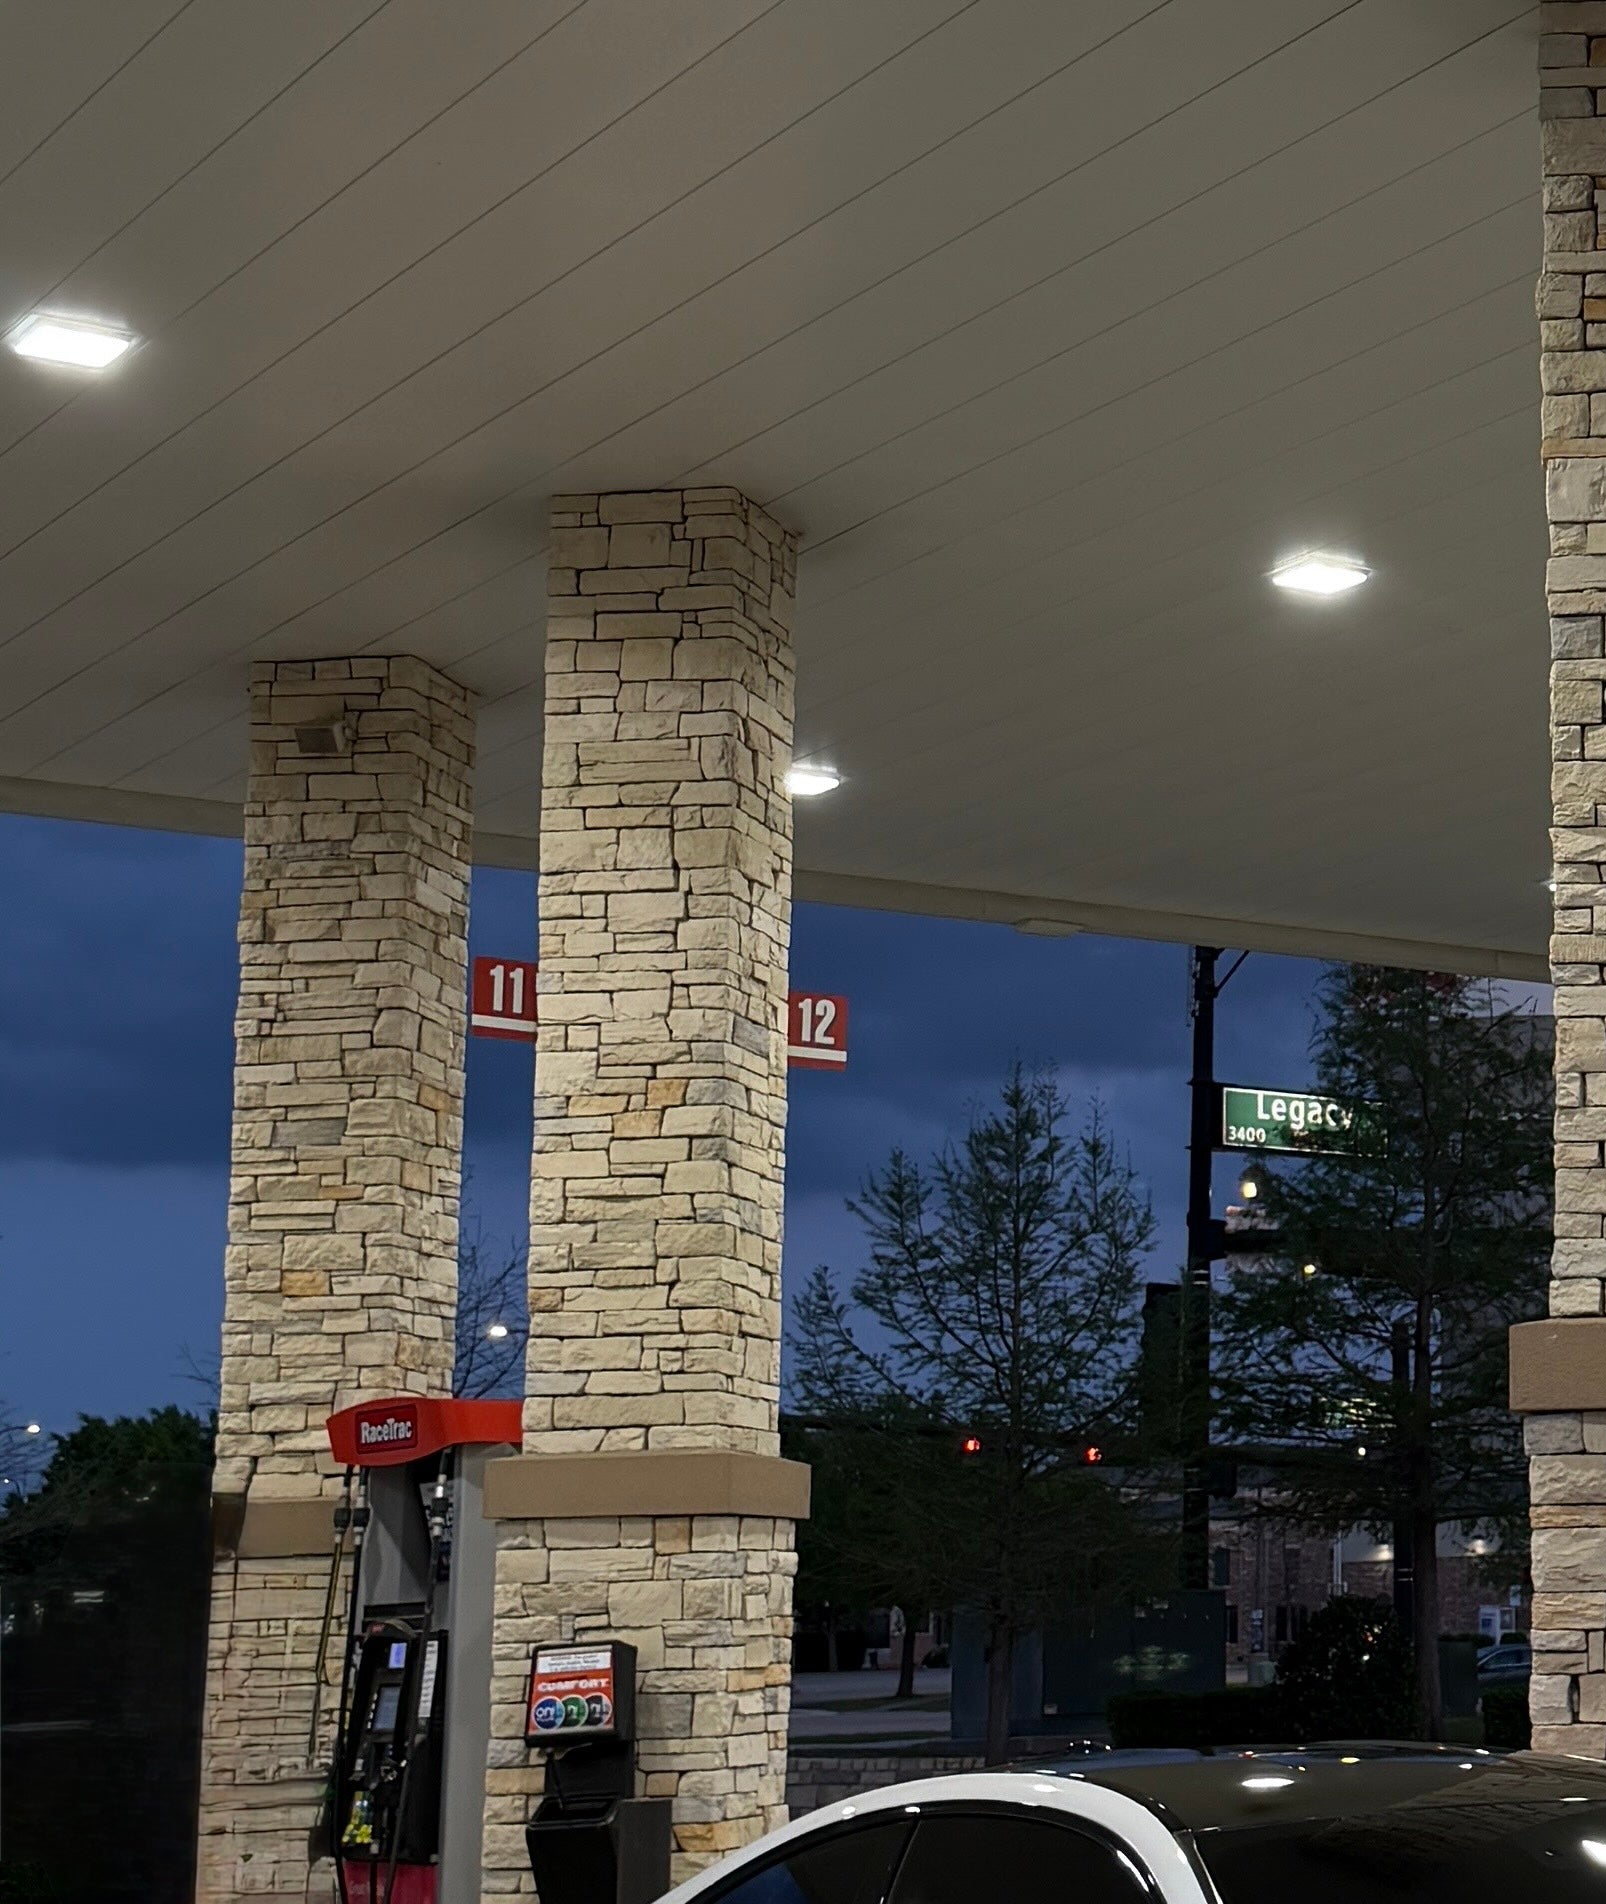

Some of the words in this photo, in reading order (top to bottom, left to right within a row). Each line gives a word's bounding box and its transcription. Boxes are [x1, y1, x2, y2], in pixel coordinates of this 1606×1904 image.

[489, 964, 524, 1015] 11
[798, 997, 837, 1045] 12
[1228, 1126, 1267, 1143] 3400
[360, 1417, 413, 1444] RaceTrac
